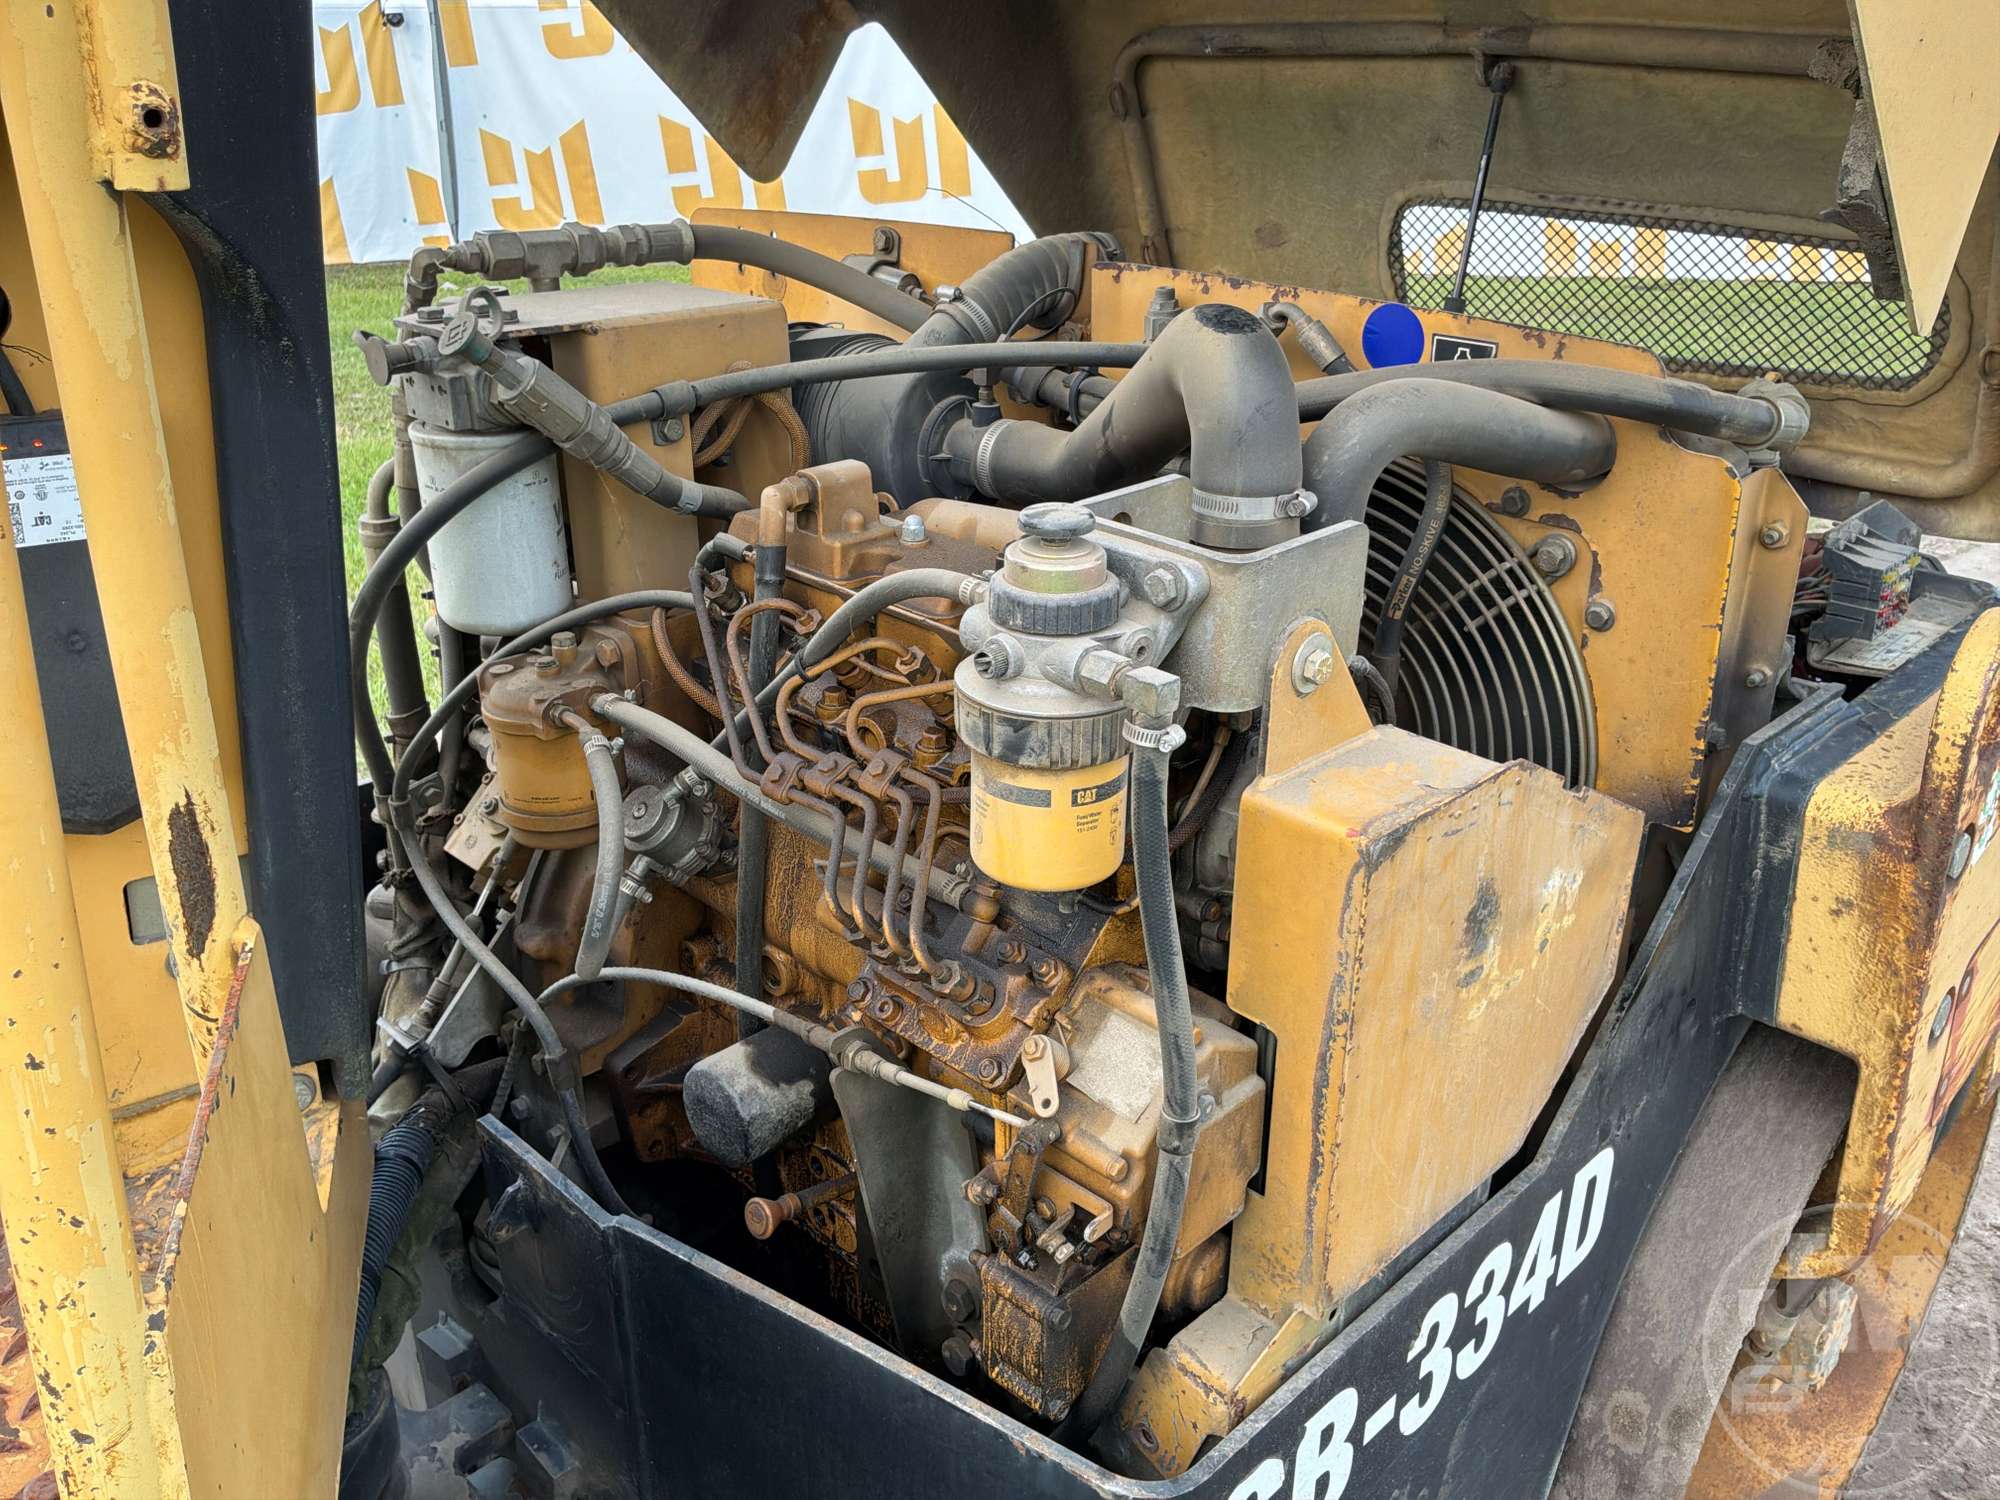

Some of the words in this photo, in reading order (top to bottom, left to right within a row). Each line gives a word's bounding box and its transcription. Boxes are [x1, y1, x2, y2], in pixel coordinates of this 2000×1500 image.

[32, 515, 52, 527] CAT
[1391, 576, 1415, 615] Parker
[1409, 519, 1441, 575] NO-SKIVE
[1078, 789, 1098, 803] CAT
[1228, 1147, 1615, 1500] B-334D
